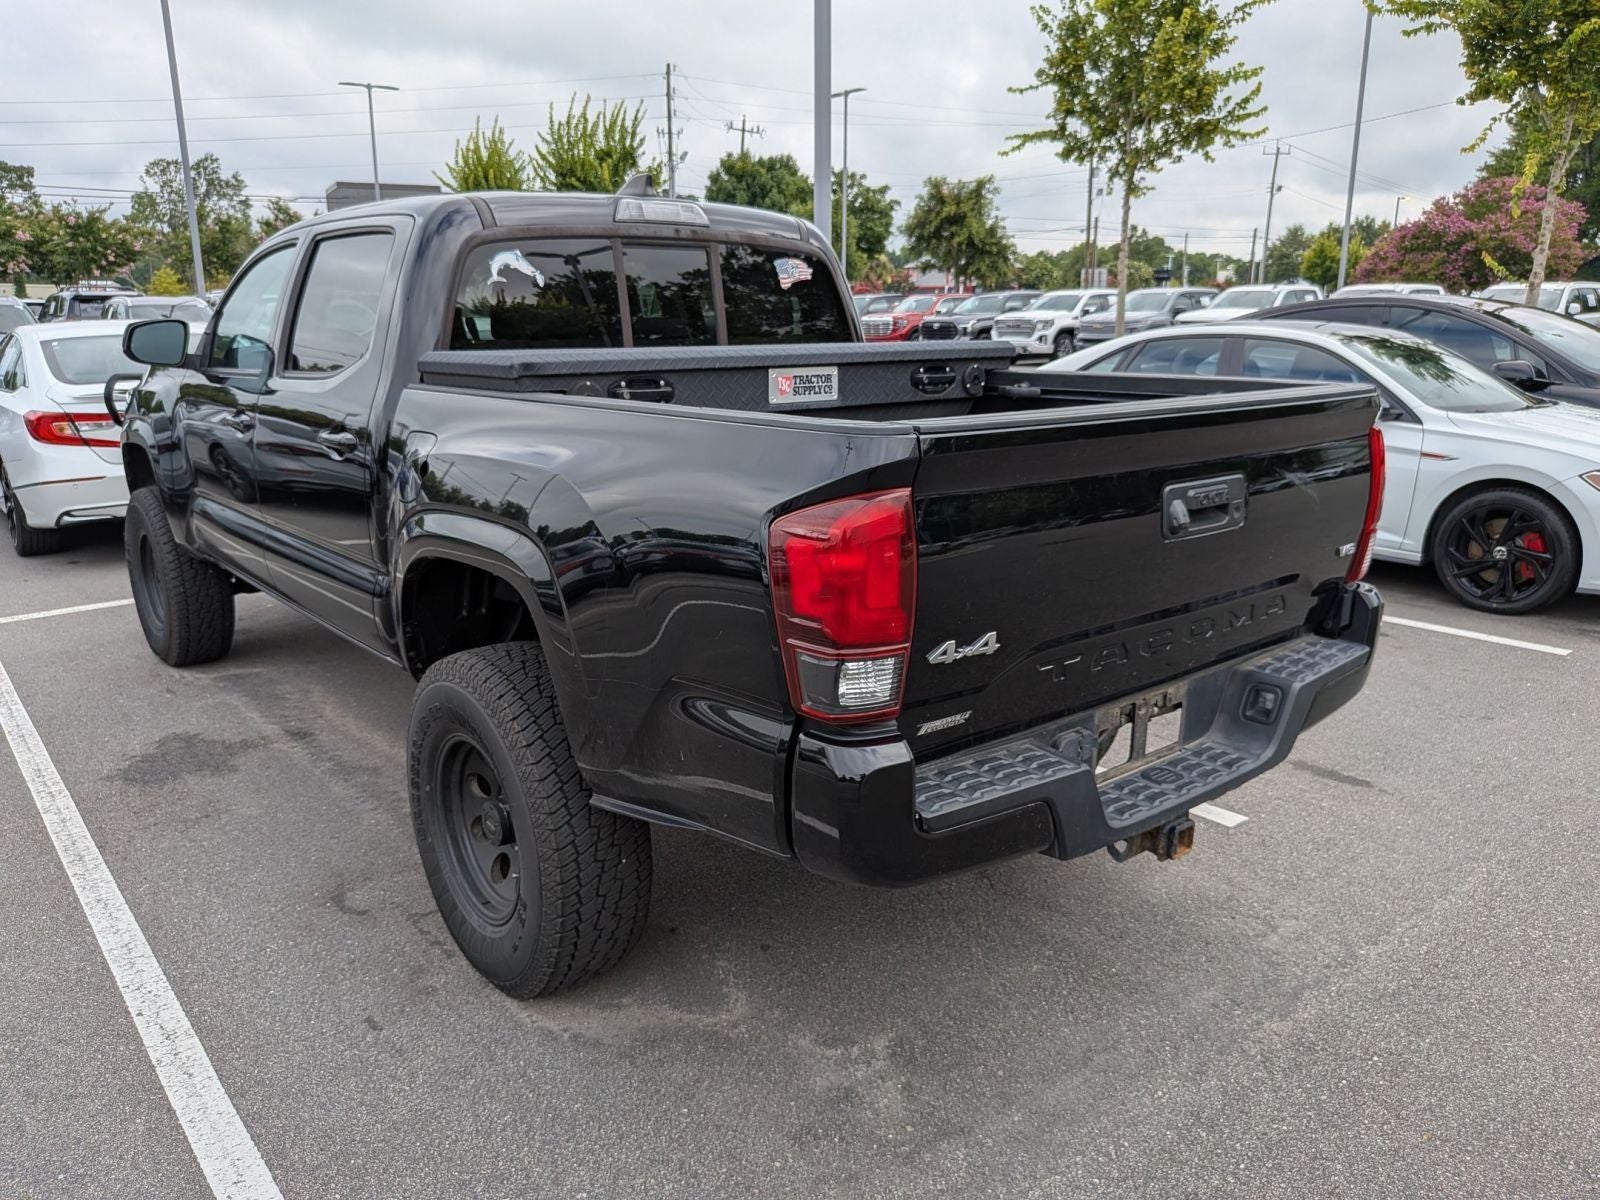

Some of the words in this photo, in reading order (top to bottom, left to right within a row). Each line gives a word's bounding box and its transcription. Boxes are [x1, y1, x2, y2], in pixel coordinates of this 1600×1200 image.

[777, 377, 790, 392] TSC
[792, 374, 833, 385] TRACTOR
[792, 385, 822, 396] SUPPLY
[1036, 594, 1286, 682] TACOMA
